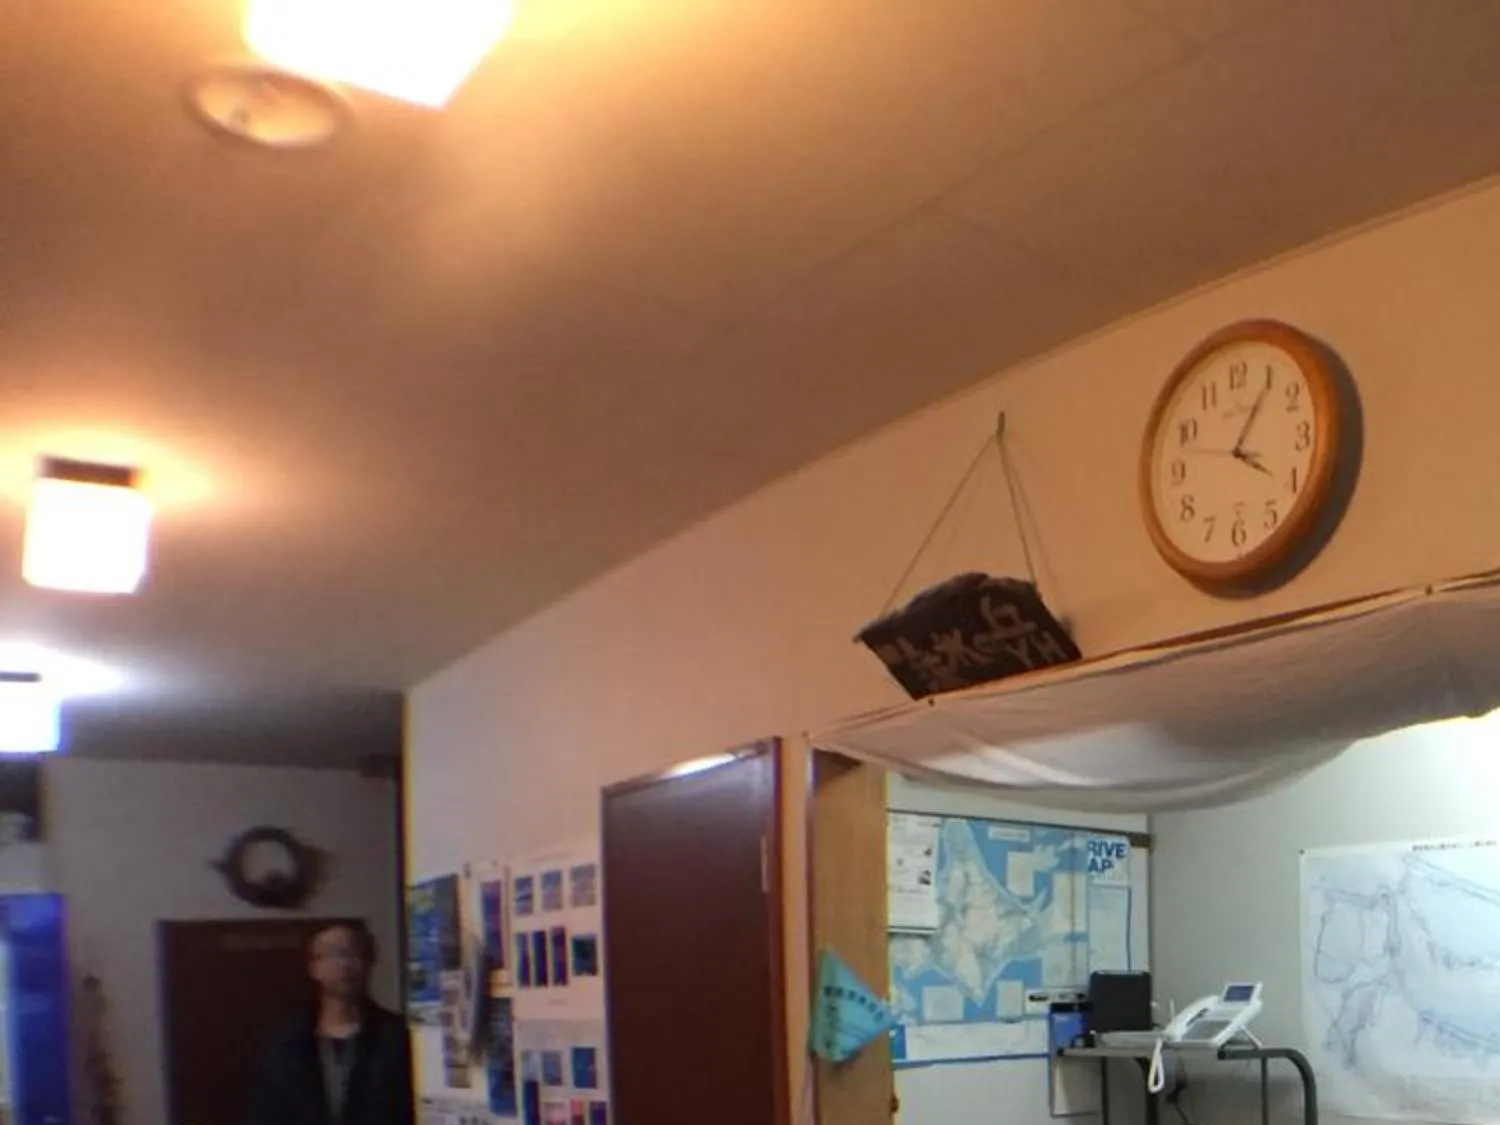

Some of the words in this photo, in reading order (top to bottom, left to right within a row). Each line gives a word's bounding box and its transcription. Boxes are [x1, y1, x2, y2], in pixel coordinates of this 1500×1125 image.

[1228, 361, 1248, 391] 12
[1264, 363, 1275, 391] 1
[1202, 381, 1217, 410] 11
[1284, 381, 1301, 413] 2
[1178, 417, 1198, 446] 10
[1294, 420, 1311, 451] 3
[1171, 458, 1186, 486] 9
[1179, 494, 1196, 523] 8
[1262, 500, 1279, 529] 5
[1202, 516, 1217, 544] 7
[1230, 518, 1248, 547] 6
